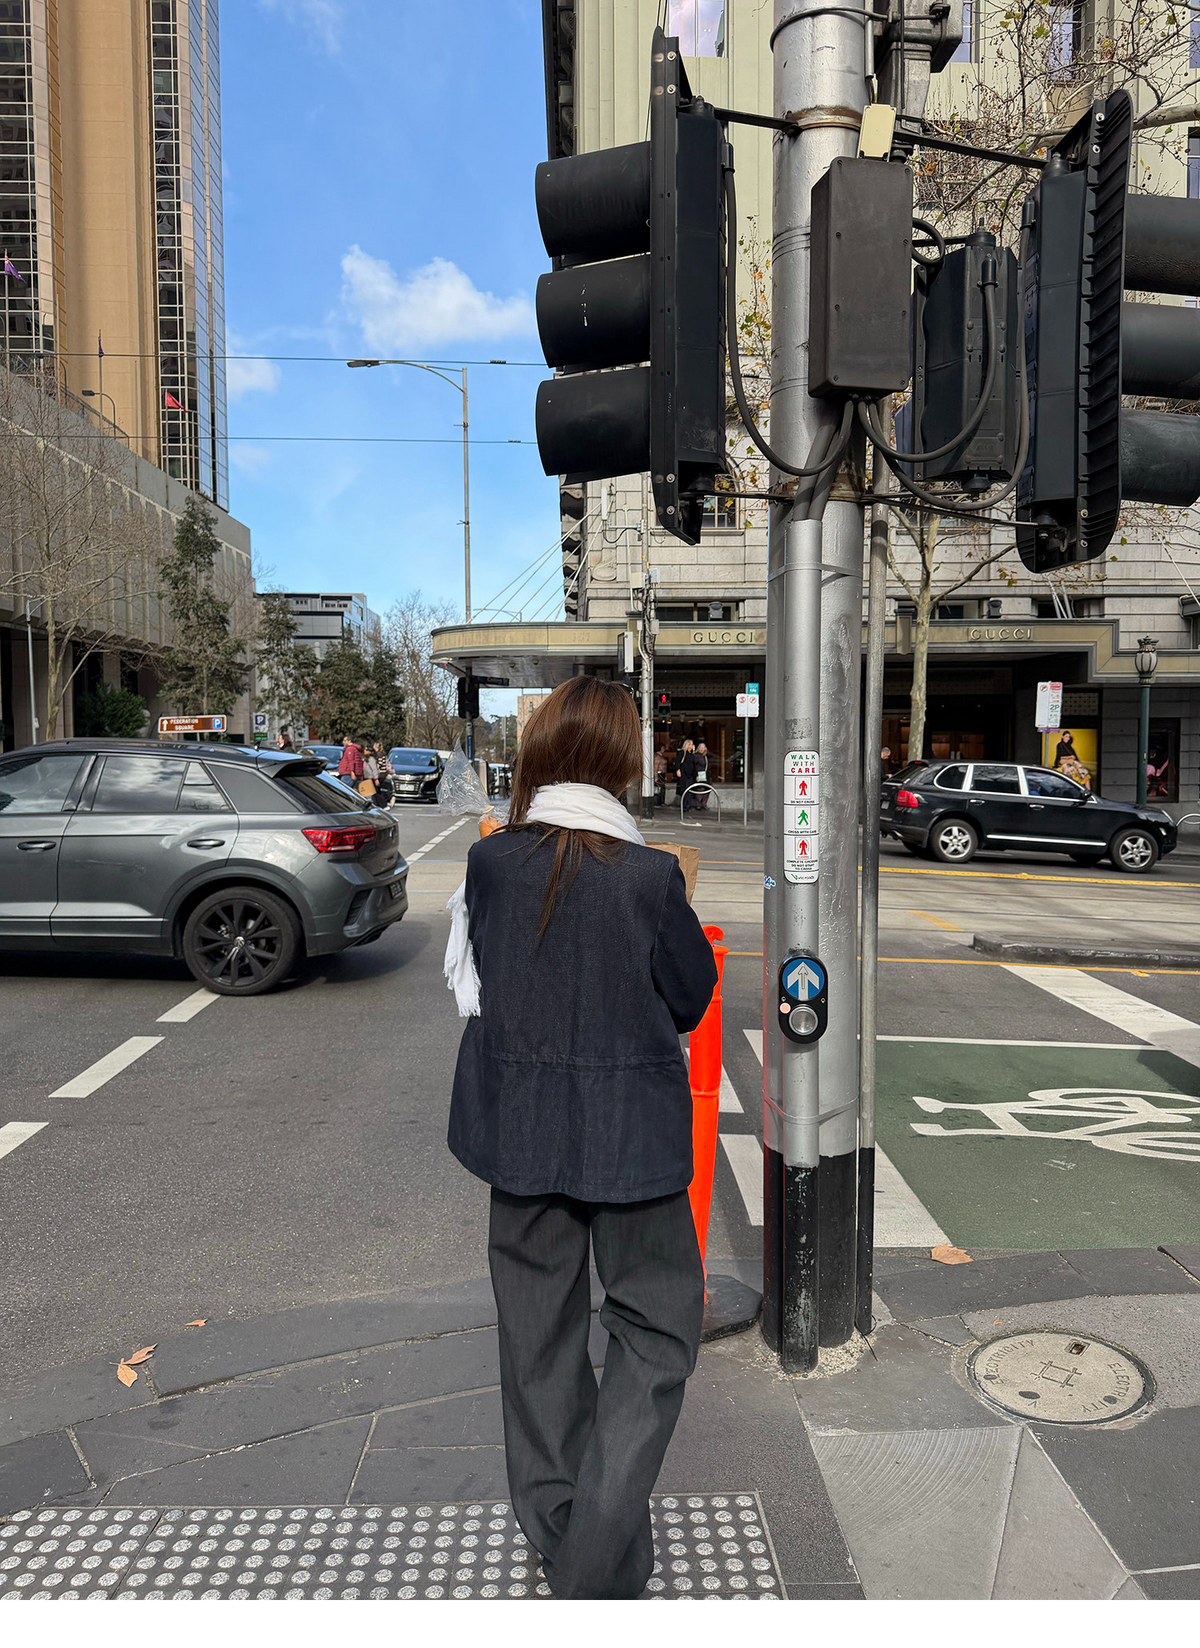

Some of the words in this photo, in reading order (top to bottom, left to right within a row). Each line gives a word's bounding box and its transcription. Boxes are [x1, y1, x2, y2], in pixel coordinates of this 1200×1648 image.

[693, 632, 753, 643] GUCCI
[970, 628, 1032, 640] GUCCI
[214, 719, 221, 728] P
[256, 716, 264, 724] P
[1081, 1362, 1131, 1413] ELECTRITY
